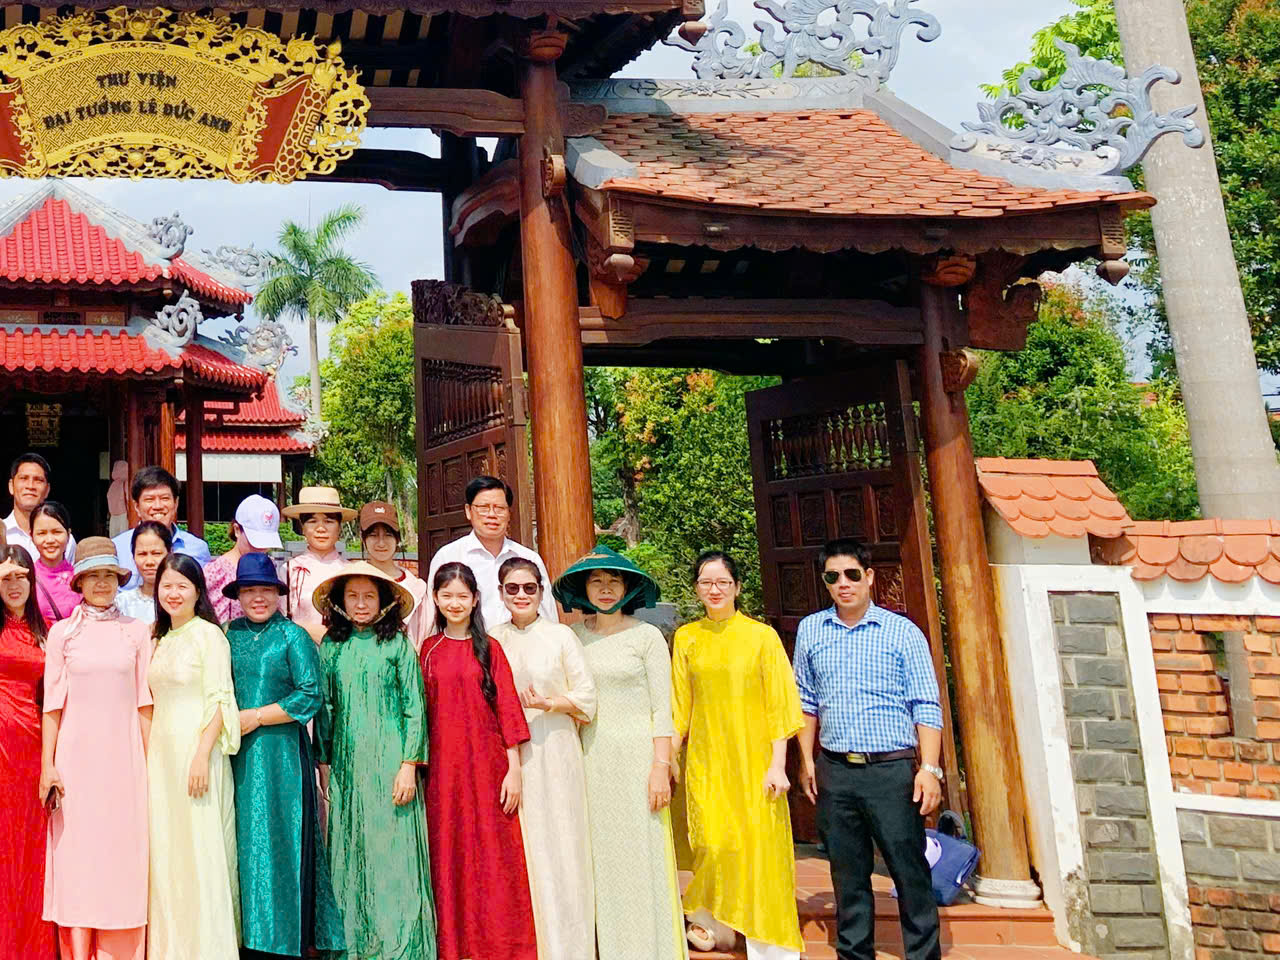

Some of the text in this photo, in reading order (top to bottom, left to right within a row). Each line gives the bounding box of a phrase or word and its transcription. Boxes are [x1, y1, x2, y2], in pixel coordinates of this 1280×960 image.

[96, 71, 177, 90] THƯ VIỆN
[43, 95, 233, 133] ĐẠI TƯỚNG LÊ ĐỨC ANH
